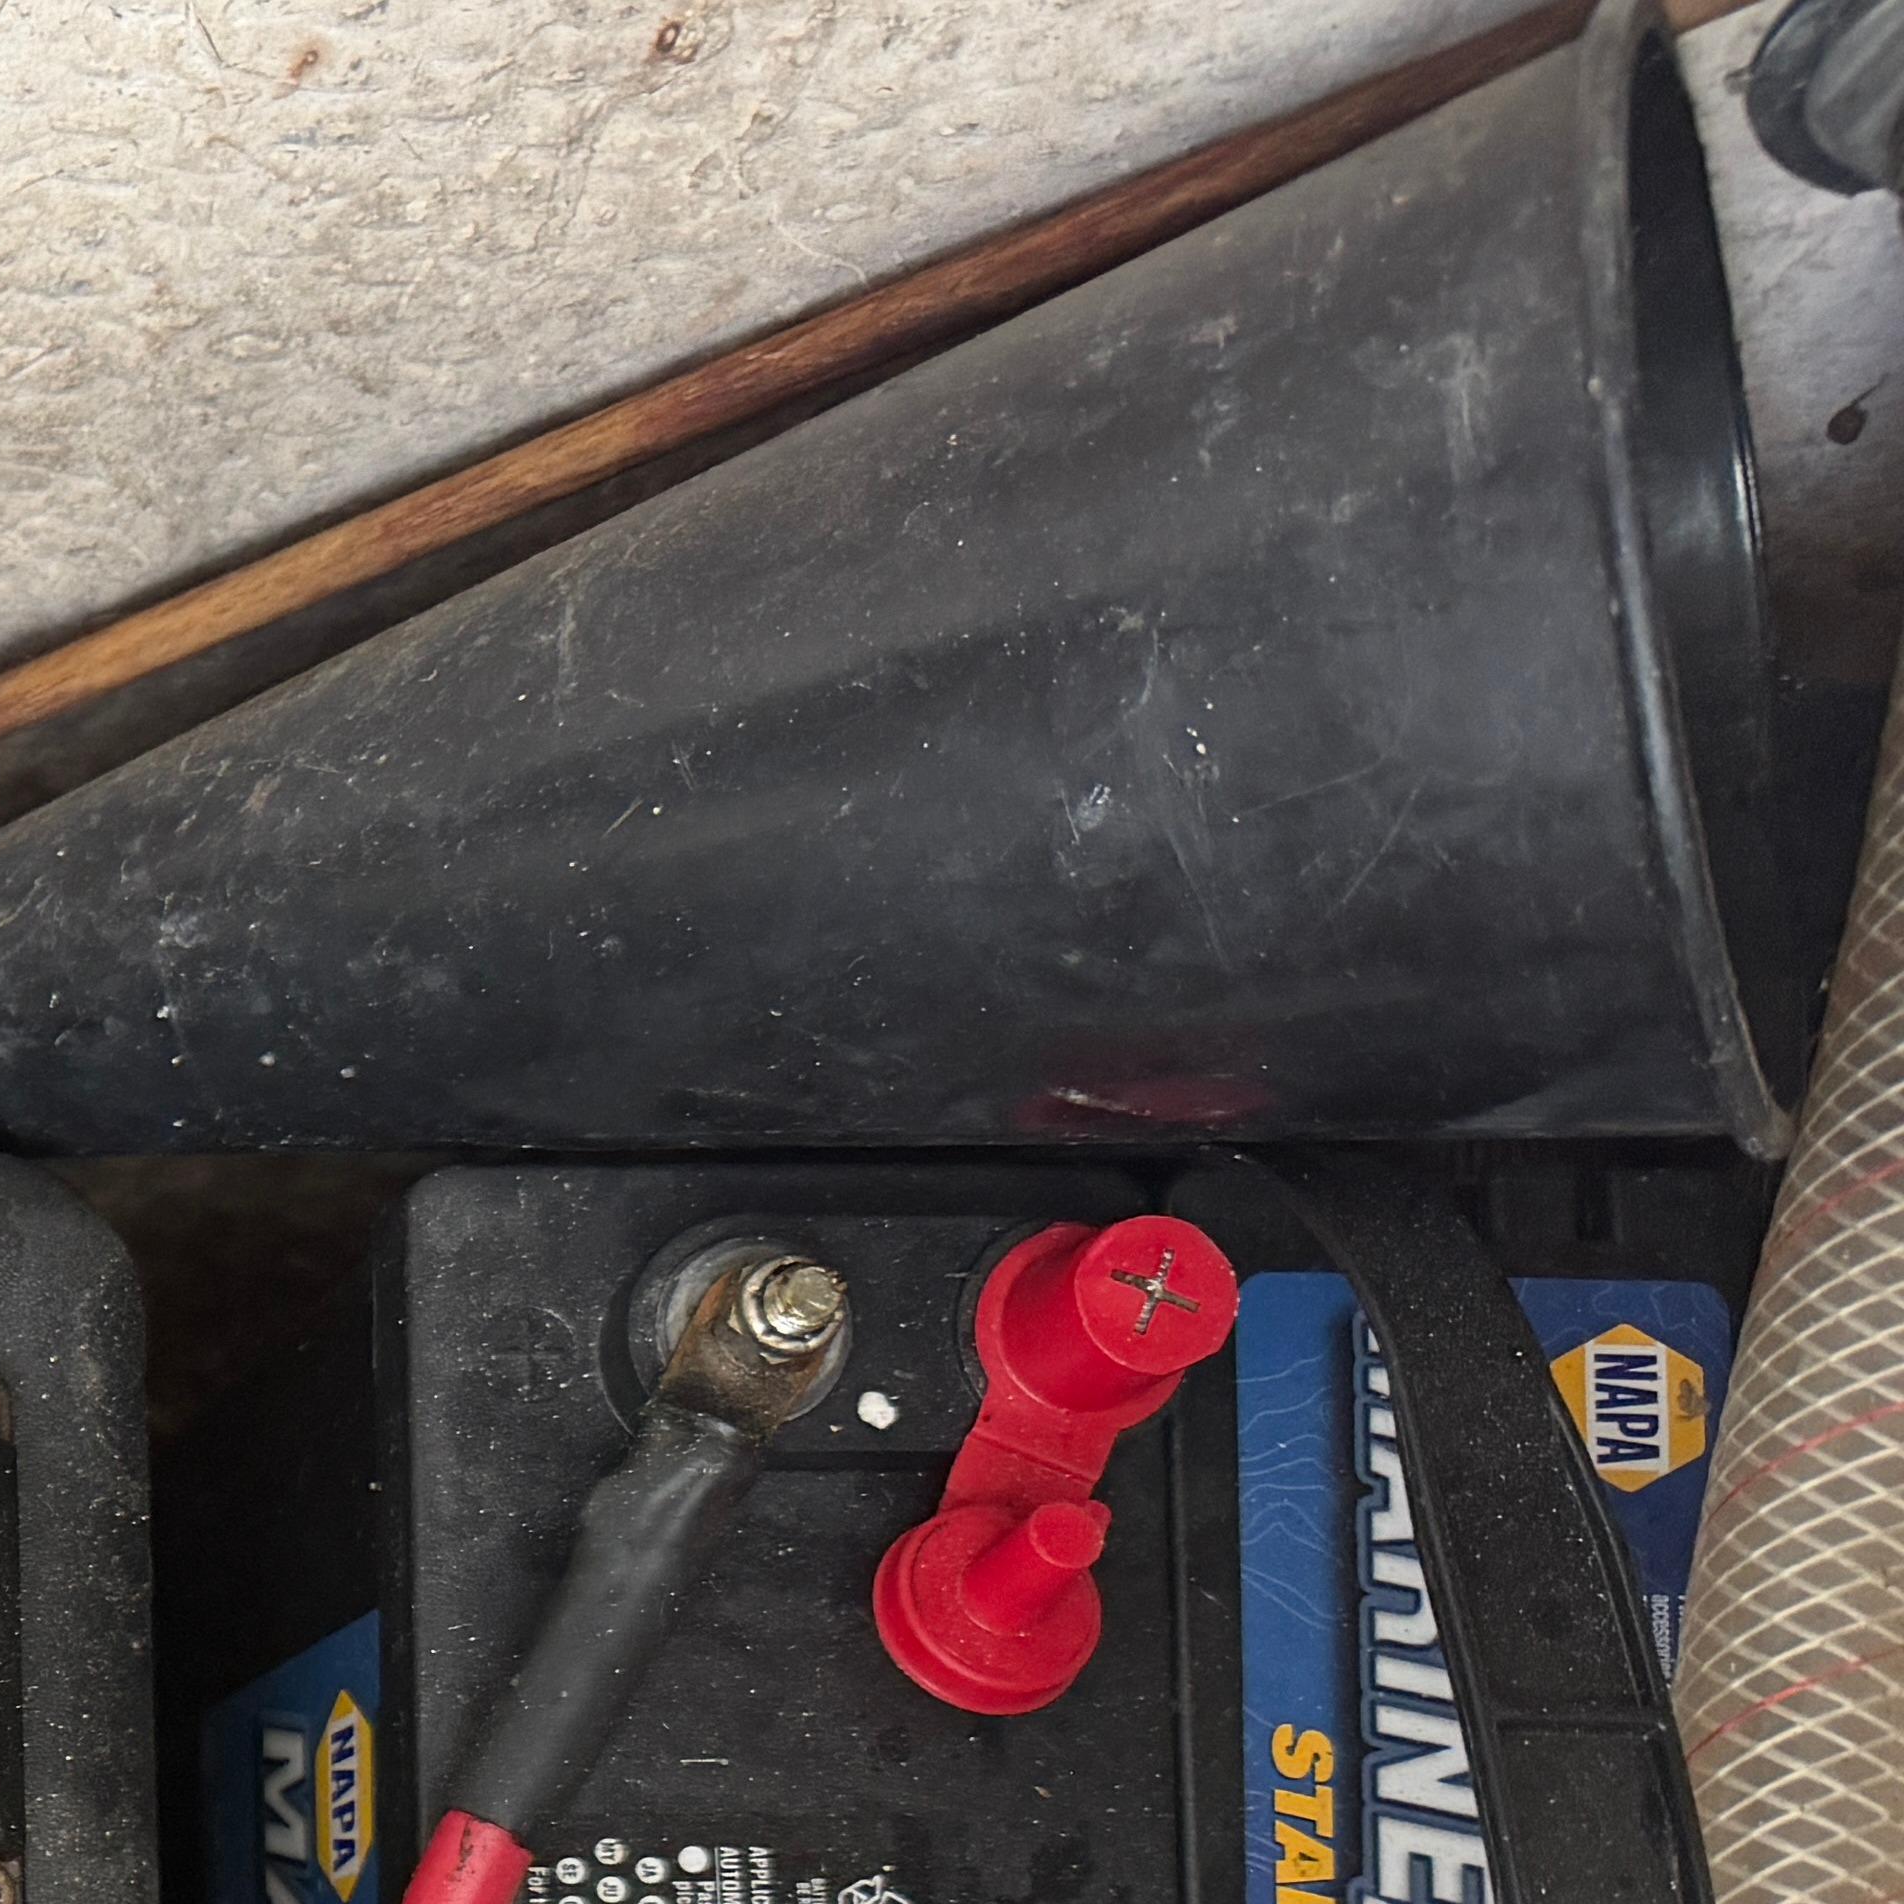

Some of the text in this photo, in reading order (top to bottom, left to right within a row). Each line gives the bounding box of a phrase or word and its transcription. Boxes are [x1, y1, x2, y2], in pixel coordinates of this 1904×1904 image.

[1594, 1353, 1661, 1465] NAPA
[331, 1724, 356, 1872] NAPA
[528, 1866, 549, 1894] For
[562, 1863, 578, 1878] SE
[642, 1863, 658, 1878] JA
[602, 1881, 618, 1898] JU
